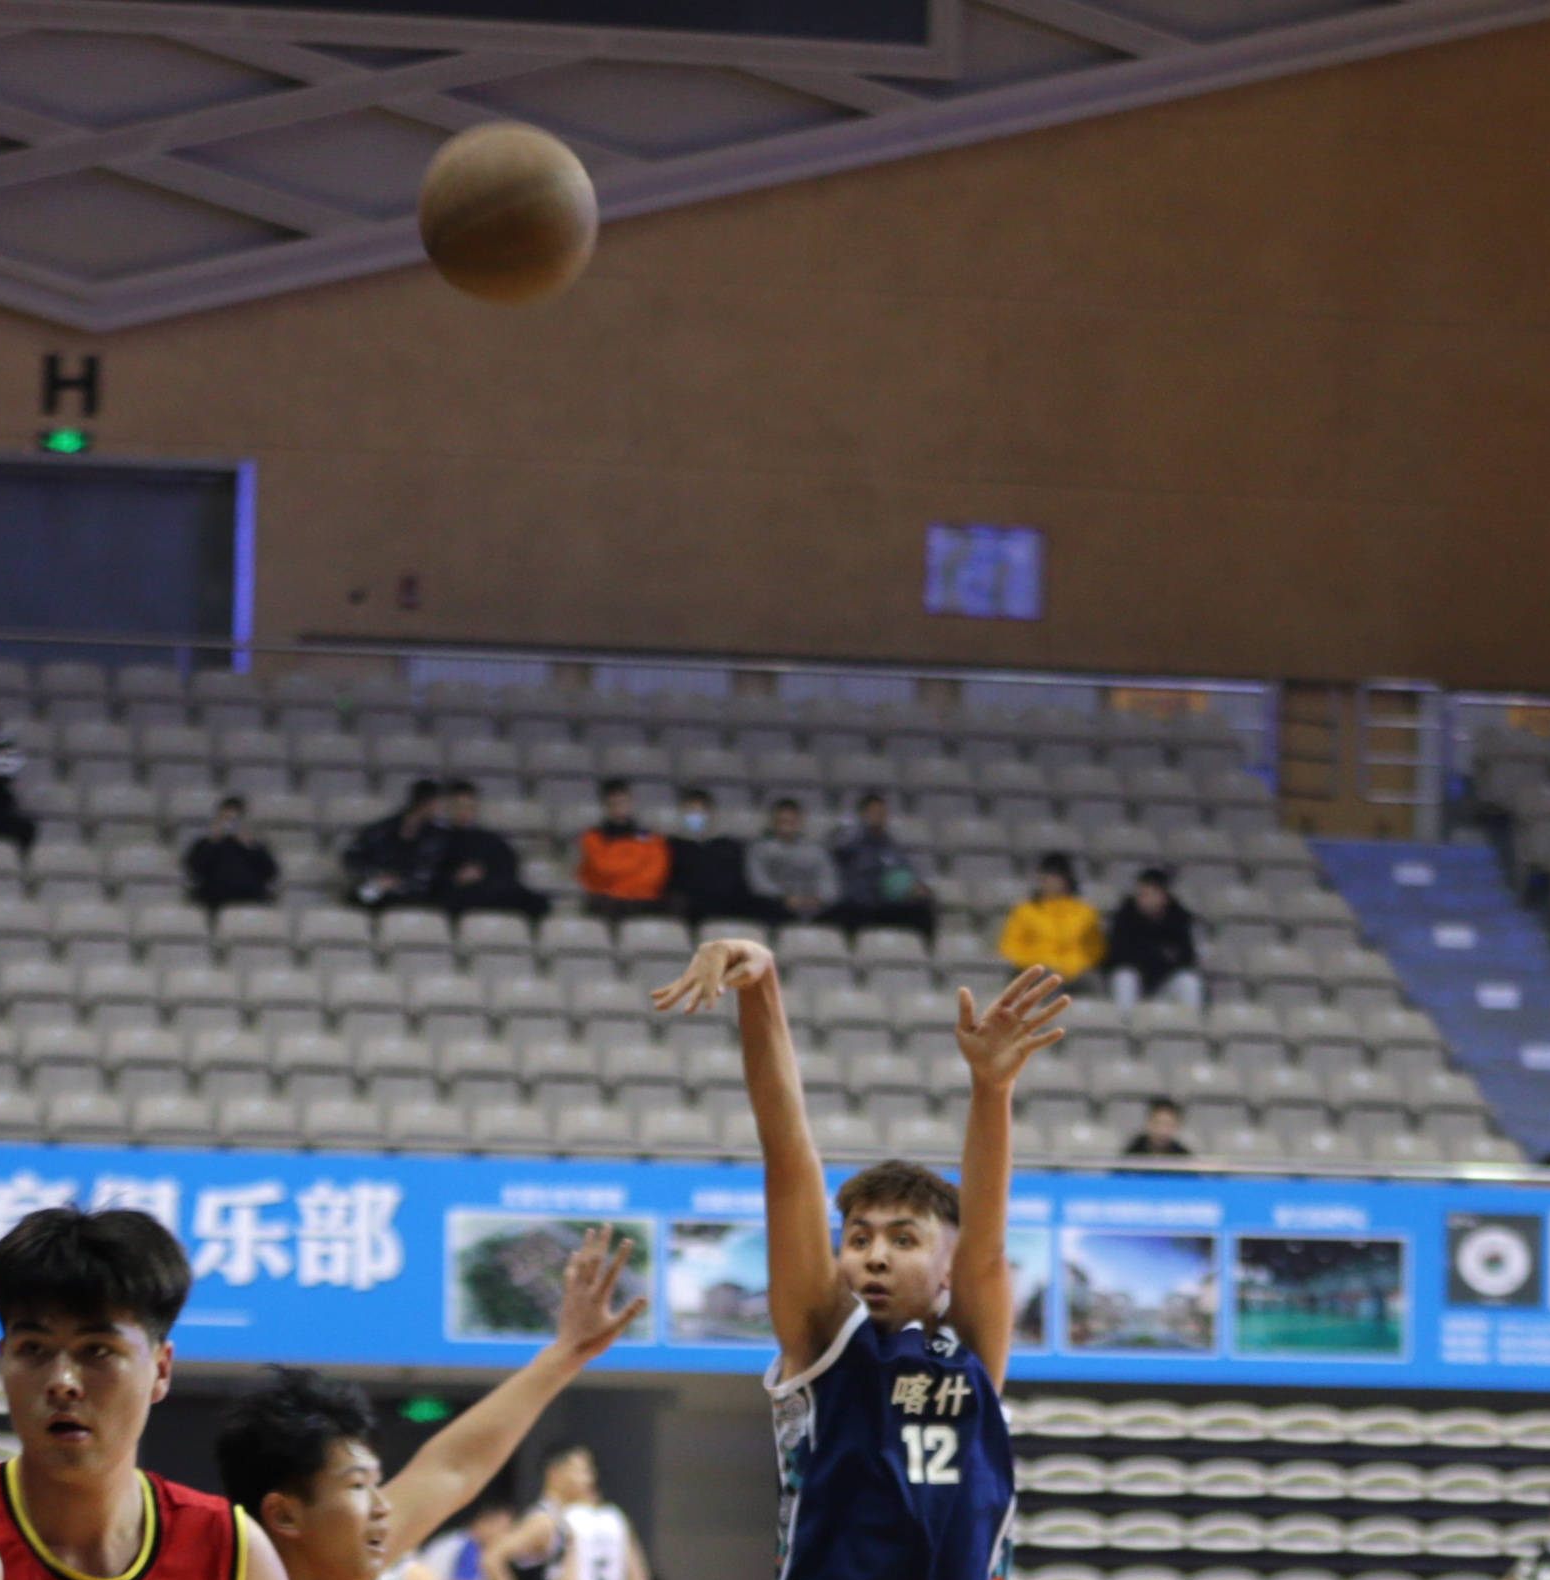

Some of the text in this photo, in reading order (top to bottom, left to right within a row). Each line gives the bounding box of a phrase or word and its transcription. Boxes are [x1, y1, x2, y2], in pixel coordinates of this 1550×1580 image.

[42, 354, 101, 417] H
[890, 1373, 972, 1417] 喀什
[900, 1423, 961, 1486] 12
